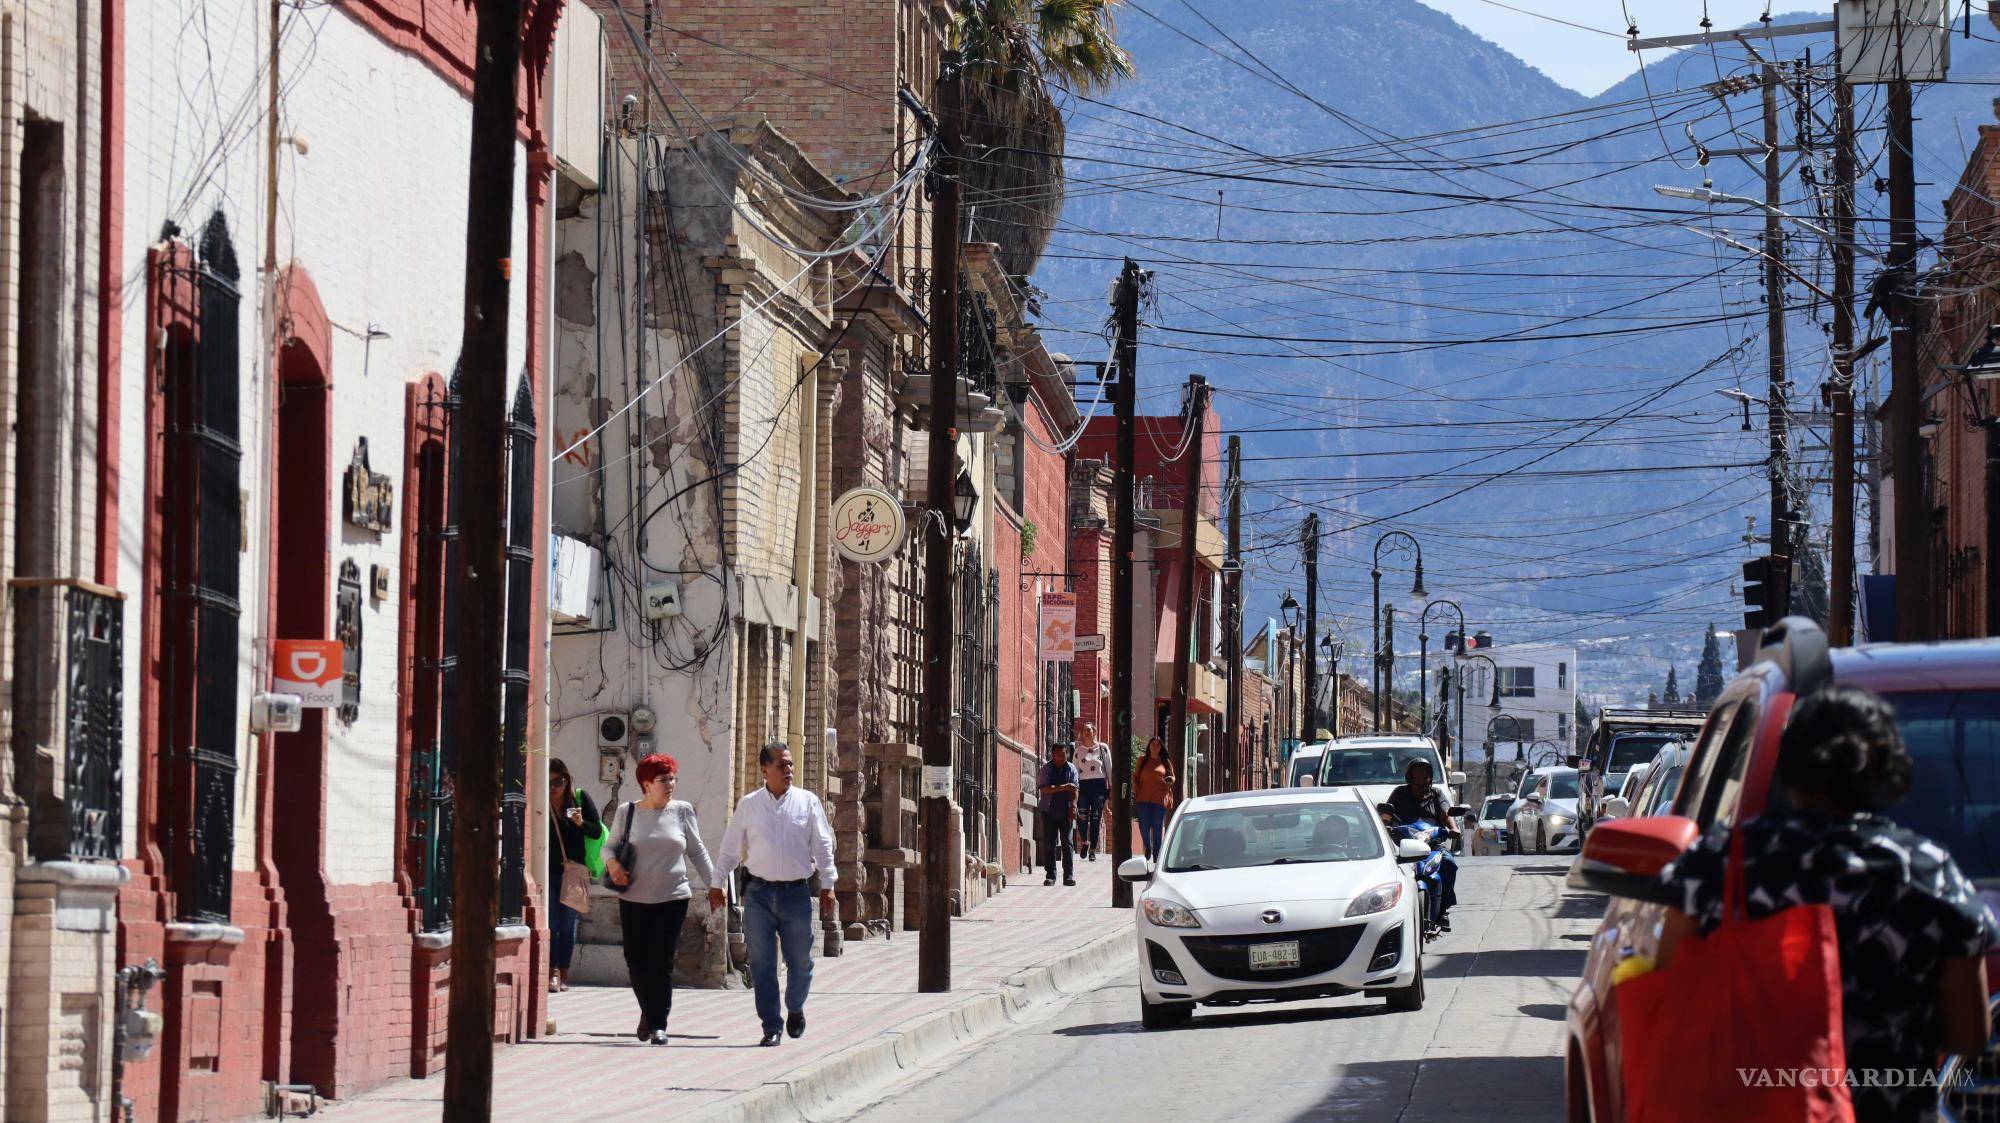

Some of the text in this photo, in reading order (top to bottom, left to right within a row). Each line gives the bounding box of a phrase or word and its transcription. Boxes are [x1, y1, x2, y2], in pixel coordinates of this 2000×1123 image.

[836, 508, 891, 541] Jaggers
[306, 692, 334, 702] Food
[1252, 949, 1298, 963] EUA-482-B
